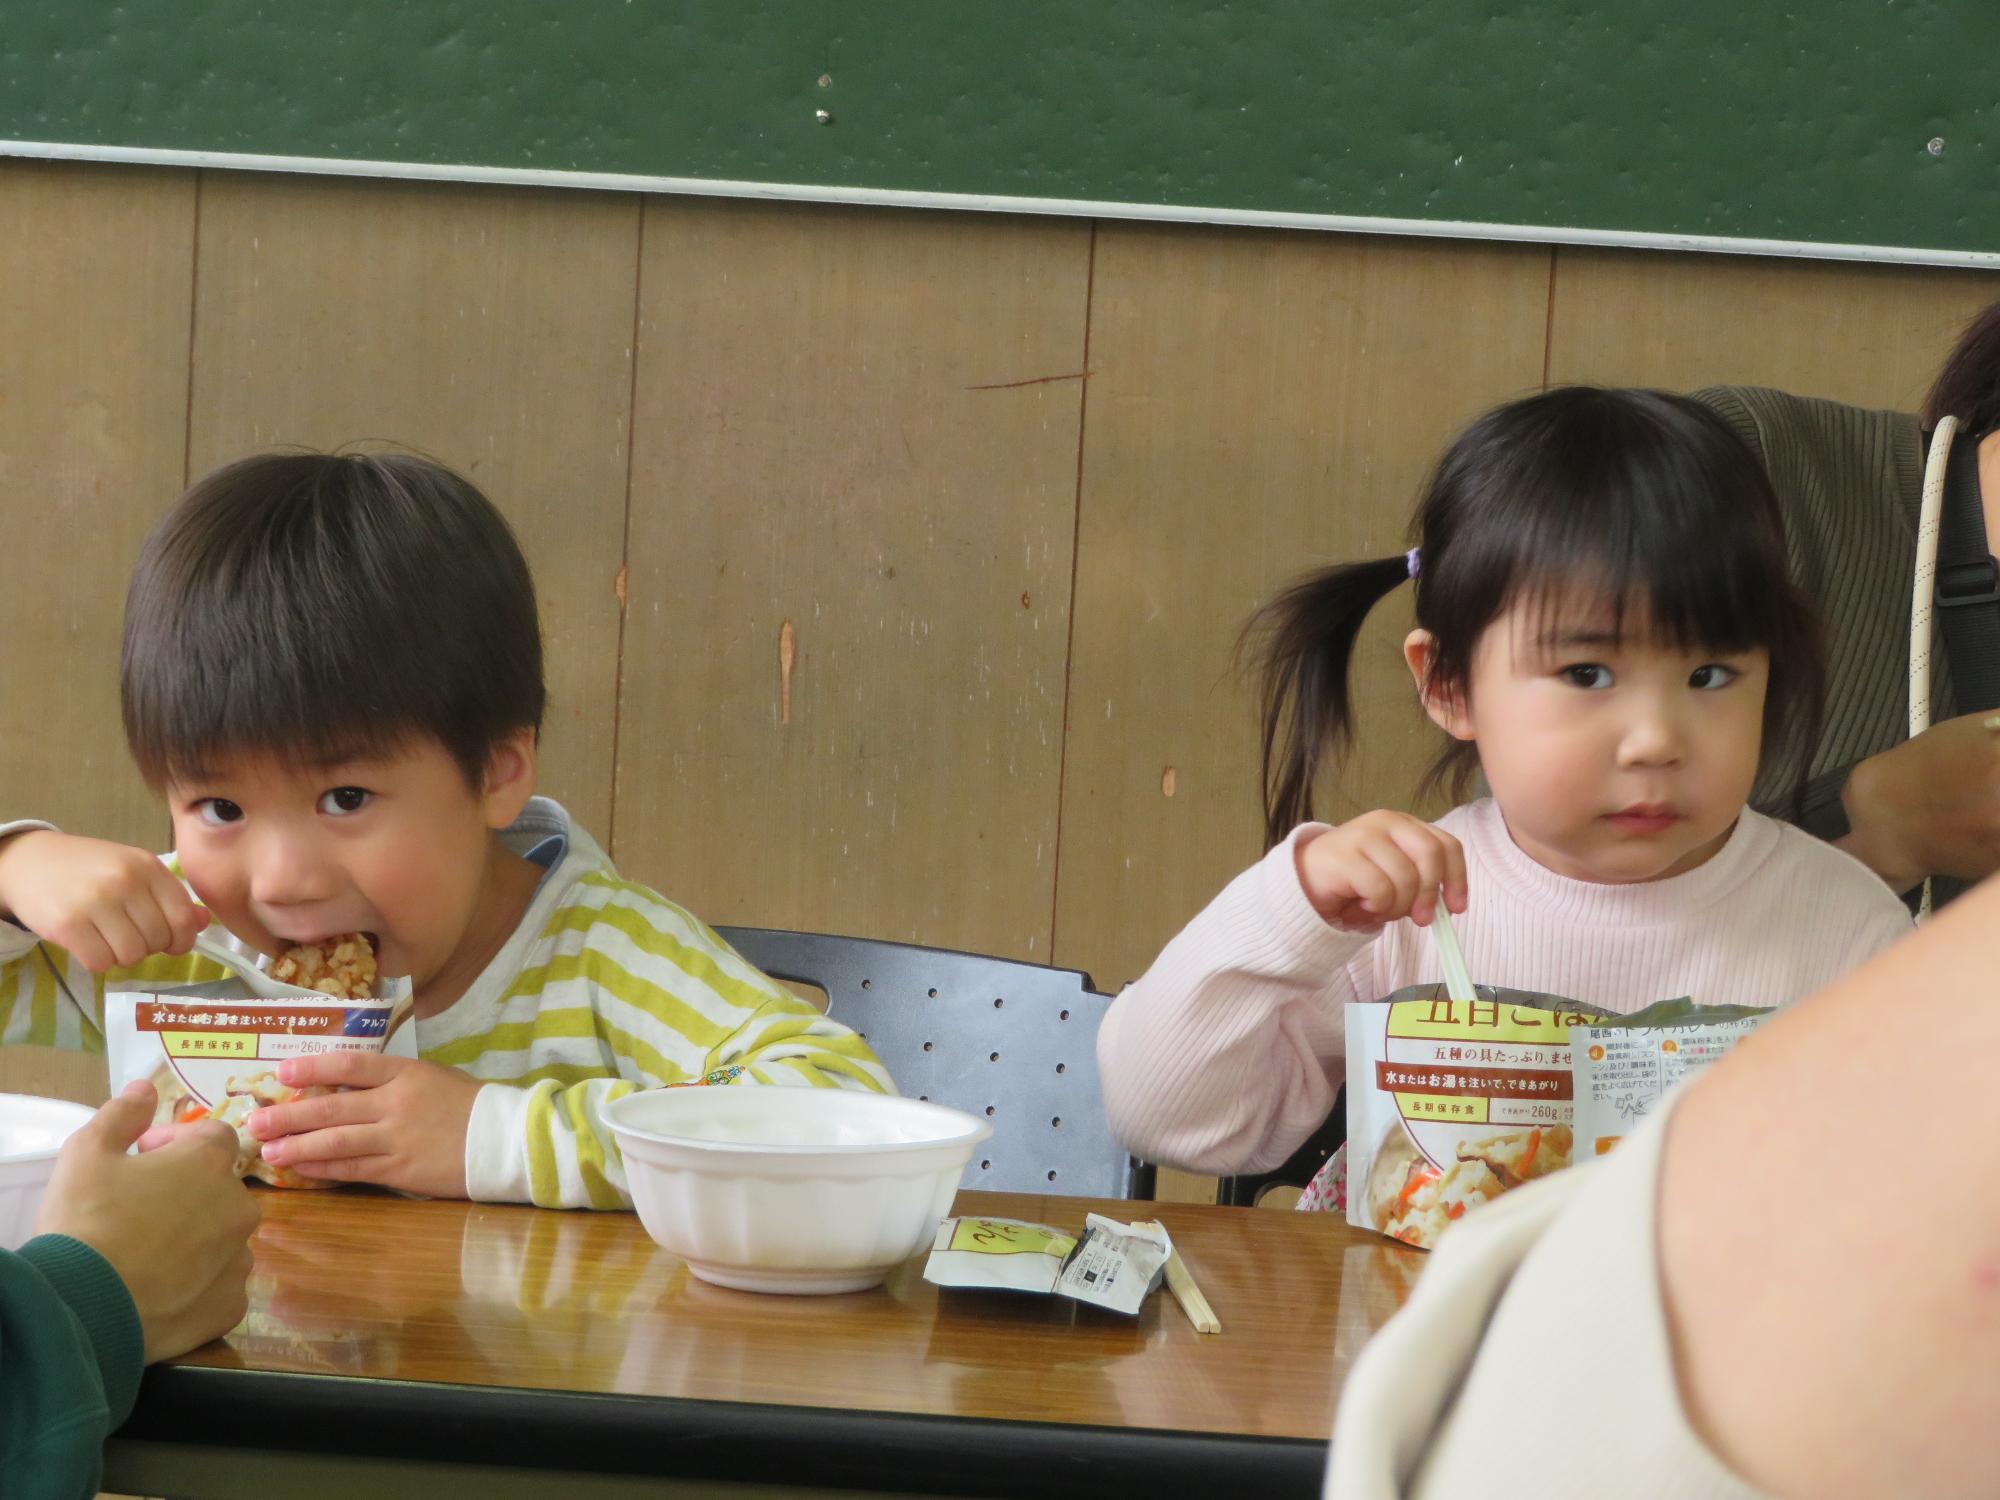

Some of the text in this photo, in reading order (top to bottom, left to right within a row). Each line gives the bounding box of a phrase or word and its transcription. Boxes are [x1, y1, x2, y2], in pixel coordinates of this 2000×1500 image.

[151, 1010, 329, 1028] 水またはお湯を注いで、できあがり
[181, 1039, 245, 1051] 長期保存食
[300, 1040, 328, 1054] 260g
[1385, 1070, 1559, 1092] 水またはお湯を注いで、できあがり
[1412, 1101, 1475, 1116] 長期保存食
[1531, 1105, 1558, 1121] 260g
